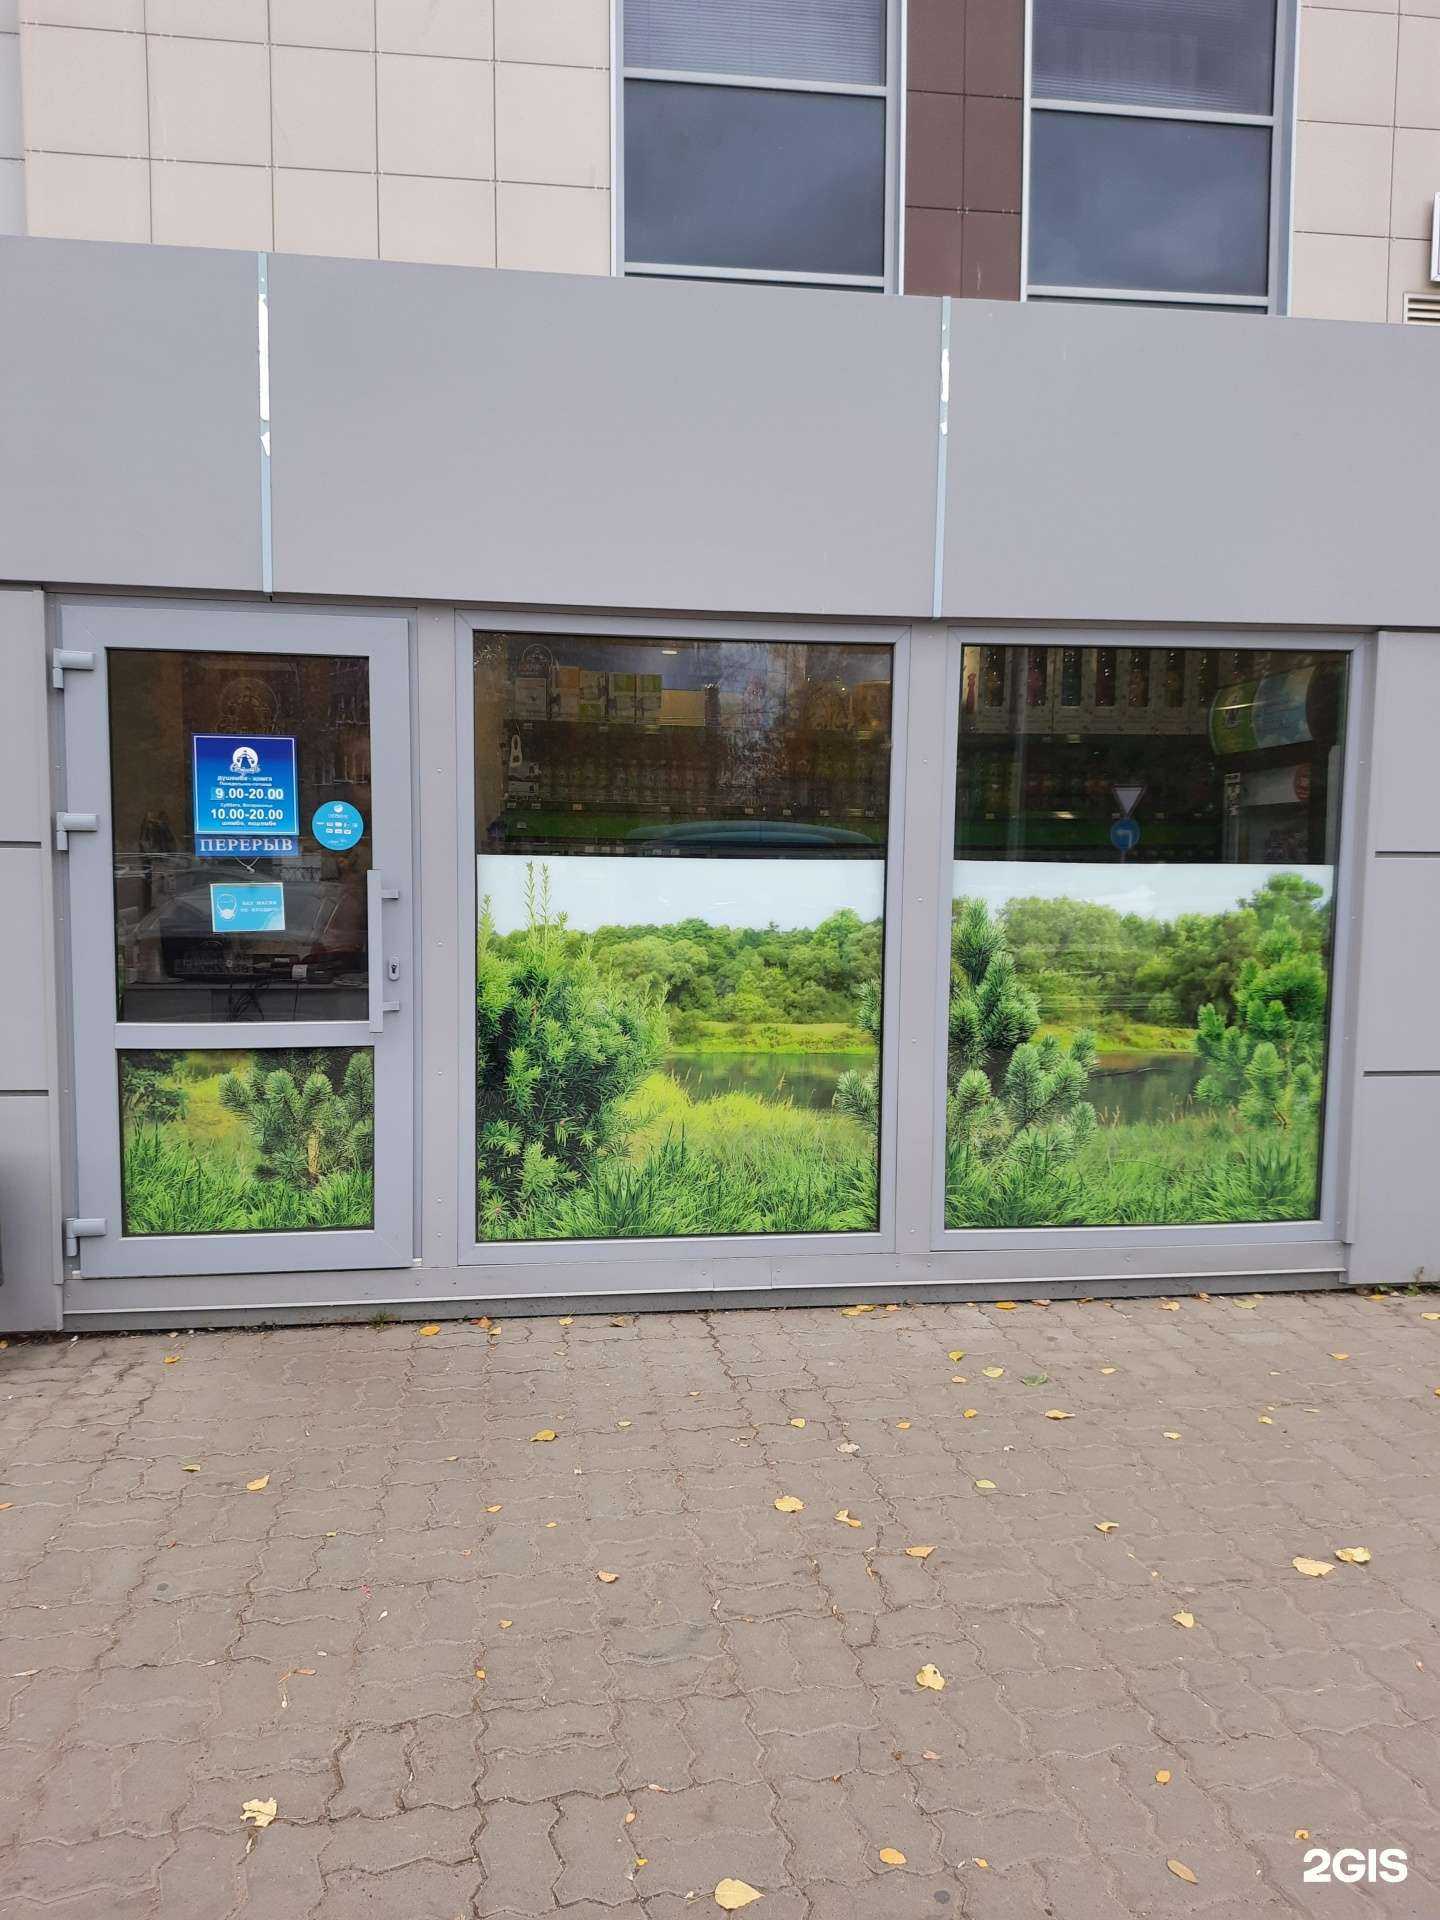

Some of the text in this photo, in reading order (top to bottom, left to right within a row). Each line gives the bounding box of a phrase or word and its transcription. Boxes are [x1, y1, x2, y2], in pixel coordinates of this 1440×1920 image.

[215, 788, 284, 800] 9.00-20.00
[211, 808, 284, 820] 10.00-20.00
[199, 838, 293, 852] ПЕРЕРЫВ
